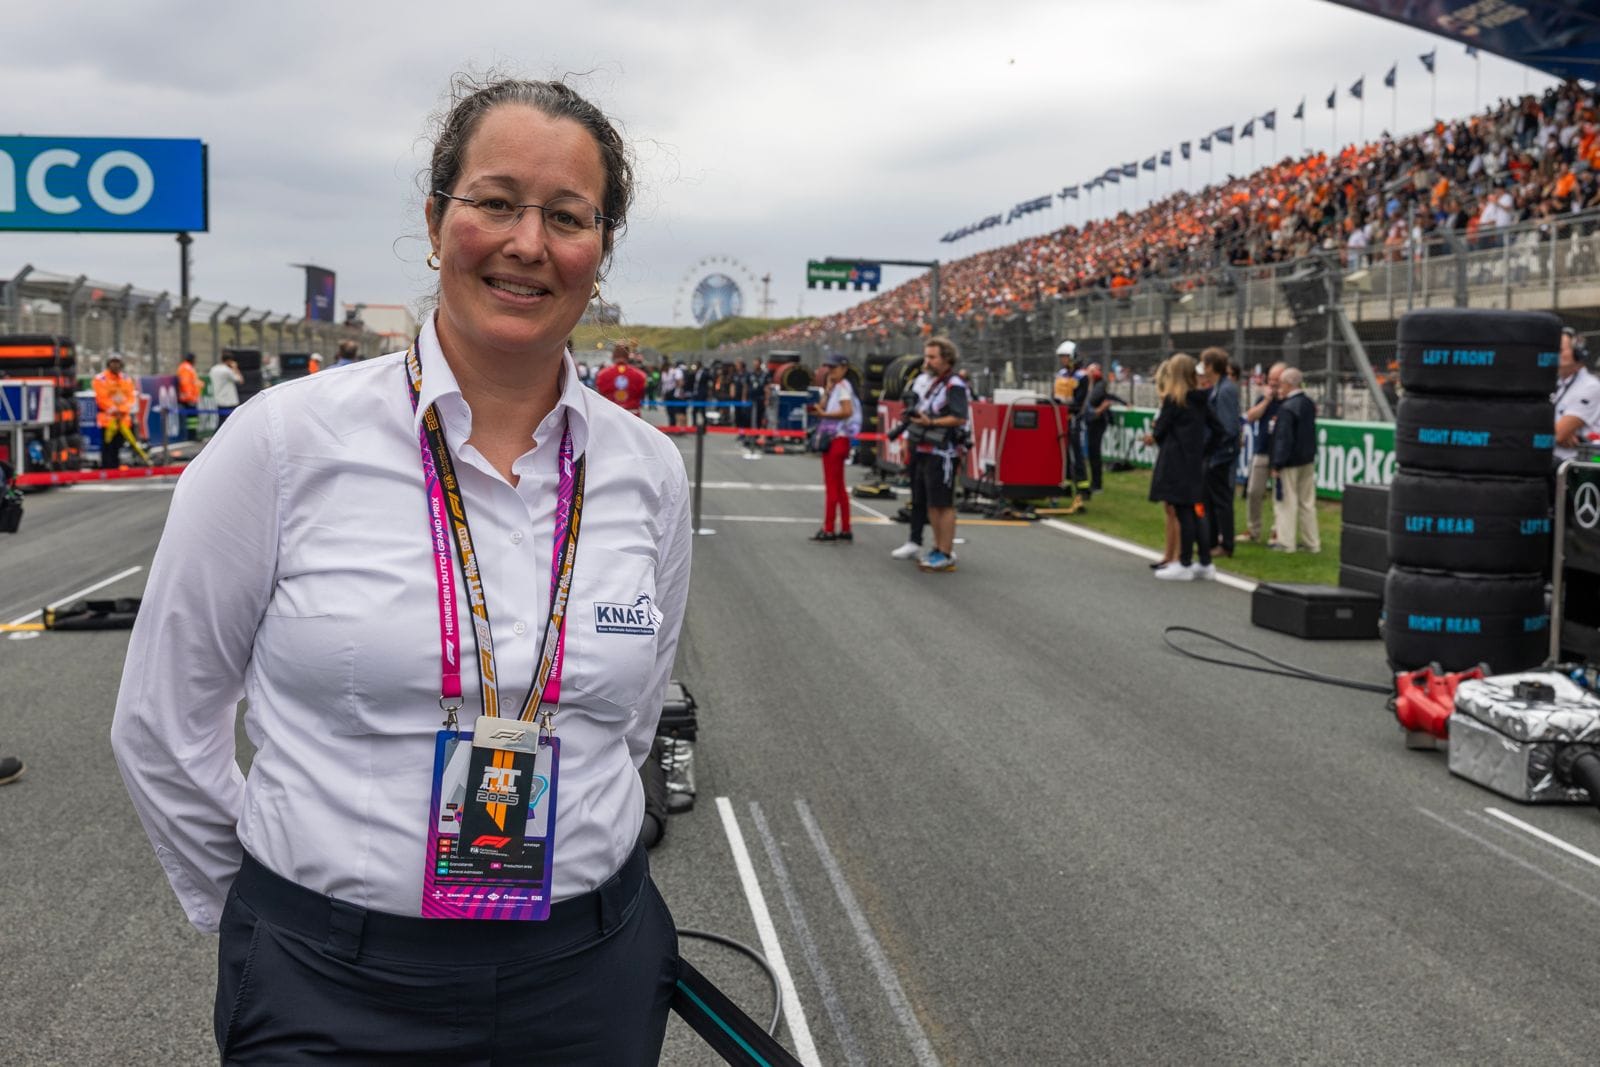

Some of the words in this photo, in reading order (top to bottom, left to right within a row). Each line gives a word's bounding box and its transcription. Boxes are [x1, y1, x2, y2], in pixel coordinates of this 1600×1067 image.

[1422, 349, 1450, 365] LEFT
[1452, 350, 1496, 366] FRONT
[1418, 427, 1449, 444] RIGHT
[1450, 429, 1491, 446] FRONT
[432, 496, 441, 516] PRIX
[435, 516, 446, 552] GRAND
[1405, 516, 1433, 532] LEFT
[1436, 517, 1475, 534] REAR
[440, 552, 449, 584] DUTCH
[443, 585, 454, 636] HEINEKEN
[596, 606, 646, 625] KNAF
[1408, 614, 1442, 632] RIGHT
[1445, 617, 1481, 633] REAR
[482, 766, 522, 789] PIT
[476, 790, 520, 806] 2025
